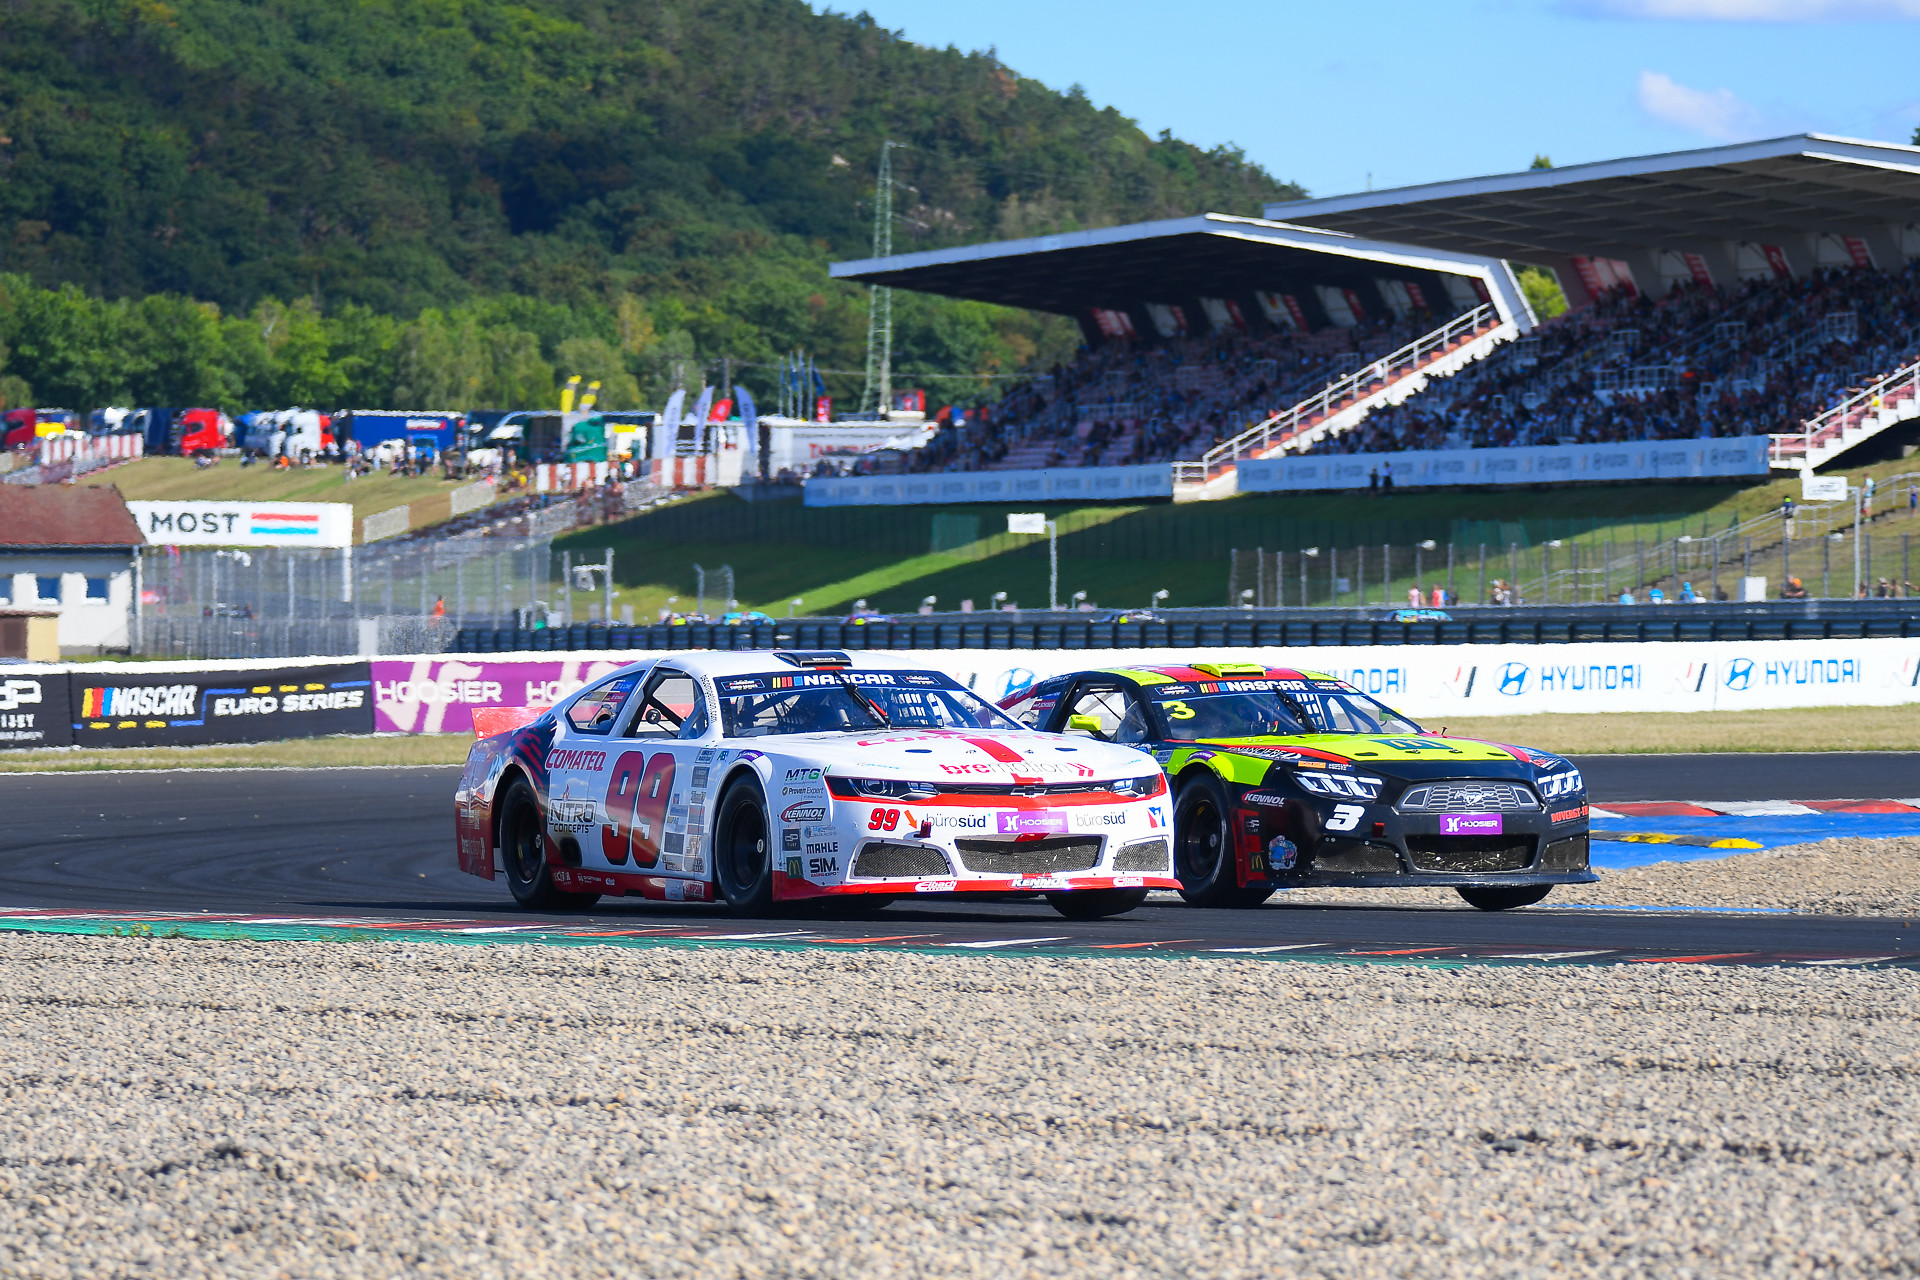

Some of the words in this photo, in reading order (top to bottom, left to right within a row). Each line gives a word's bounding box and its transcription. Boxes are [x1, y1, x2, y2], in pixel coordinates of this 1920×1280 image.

[150, 512, 240, 534] MOST
[803, 673, 897, 687] NASCAR
[1541, 663, 1642, 691] HYUNDAI
[1766, 658, 1862, 685] HYUNDAI
[375, 679, 503, 703] HOOSIER
[1229, 681, 1309, 692] NASCAR
[111, 685, 199, 717] NASCAR
[214, 696, 278, 716] EURO
[282, 690, 365, 712] SERIES
[1162, 701, 1196, 720] 3
[546, 749, 607, 772] COMATEQ
[939, 761, 1073, 775] bremotion
[1244, 793, 1286, 805] KENNOL
[550, 802, 595, 823] NITRO
[602, 750, 676, 870] 99
[784, 808, 825, 819] KENNOL
[868, 808, 901, 831] 99
[1076, 811, 1126, 827] bürosüd
[1325, 803, 1366, 831] 3
[553, 823, 589, 834] CONCEPTS
[926, 813, 986, 828] bürosüd
[1460, 820, 1498, 828] HOOSIER
[806, 841, 839, 854] MAHLE
